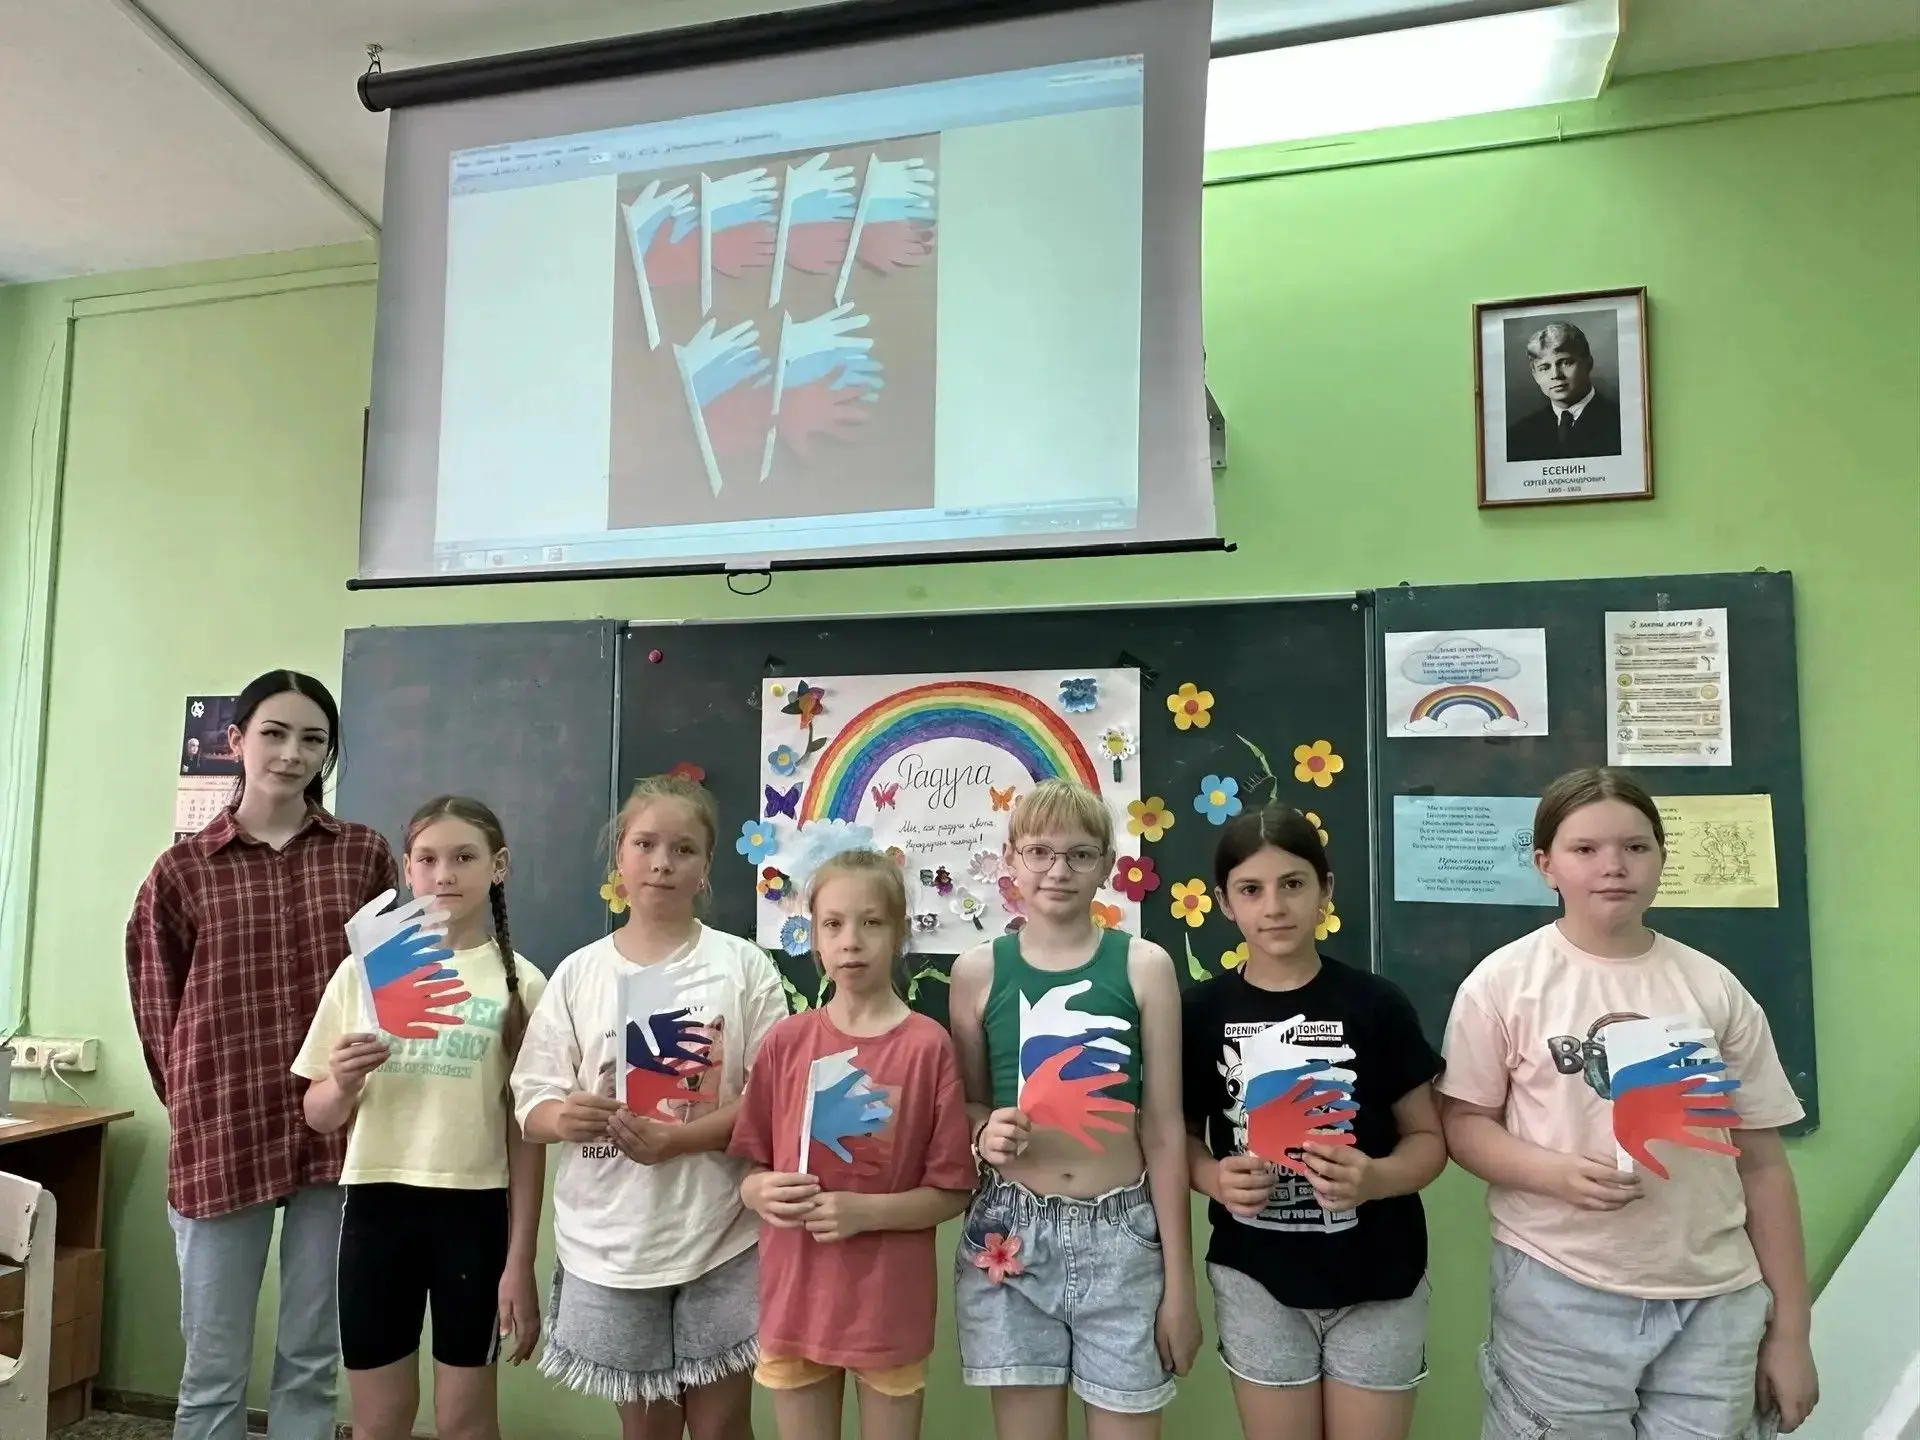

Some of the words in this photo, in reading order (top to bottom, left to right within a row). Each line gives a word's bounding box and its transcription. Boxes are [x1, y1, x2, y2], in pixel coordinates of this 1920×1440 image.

[1542, 465, 1586, 476] ЕСЕНИН
[1523, 479, 1547, 487] СЕРГЕЙ
[1548, 476, 1606, 486] АЛЕКСАНДРОВИЧ
[898, 754, 993, 810] Радуга
[1297, 1024, 1338, 1034] TONIGHT
[582, 1146, 619, 1159] BREAD
